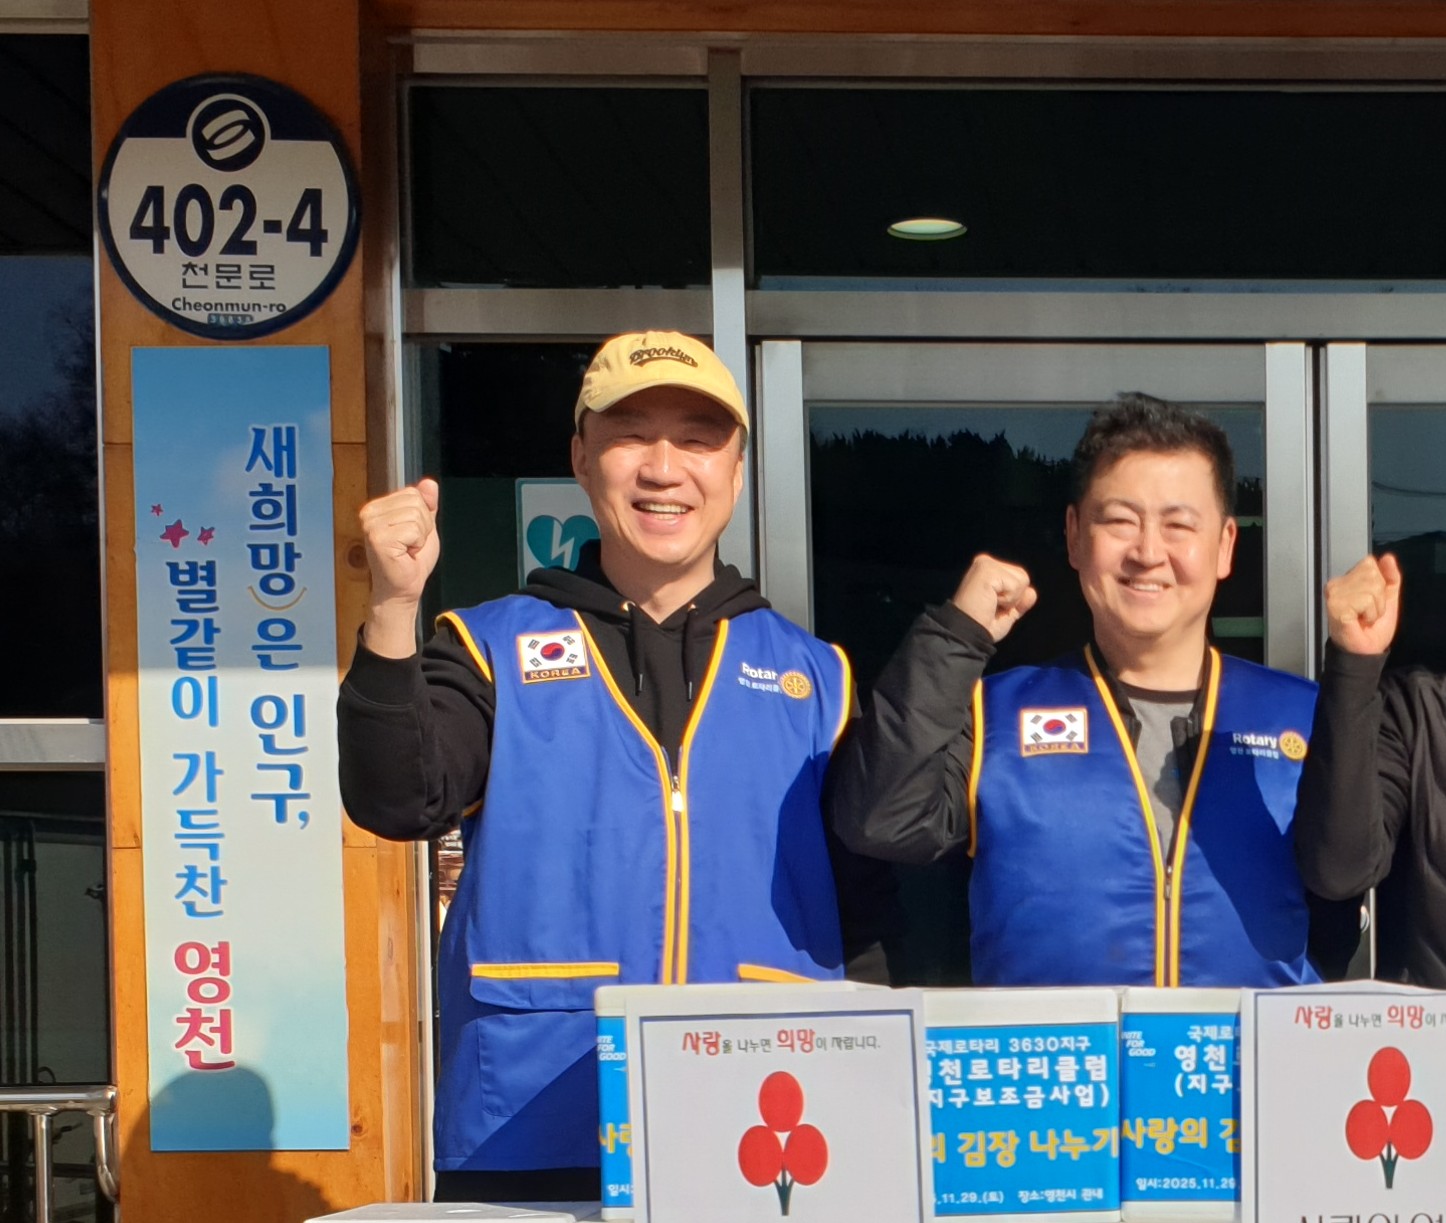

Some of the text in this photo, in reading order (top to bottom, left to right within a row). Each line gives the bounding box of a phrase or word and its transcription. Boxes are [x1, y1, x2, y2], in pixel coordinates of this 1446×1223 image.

[130, 183, 328, 257] 402-4
[182, 261, 276, 290] 천문로
[171, 297, 287, 313] Cheonmun-ro
[245, 425, 310, 829] 새희망은 인구,
[166, 560, 221, 727] 별같이
[529, 667, 582, 680] KOREA
[741, 662, 779, 681] Rotar
[1232, 731, 1278, 750] Rotary
[173, 940, 235, 1071] 영천
[1349, 1014, 1382, 1028] 나누면
[737, 1038, 771, 1053] 나누면
[1009, 1036, 1091, 1052] 3630지구
[957, 1127, 1118, 1168] 김장 나누기
